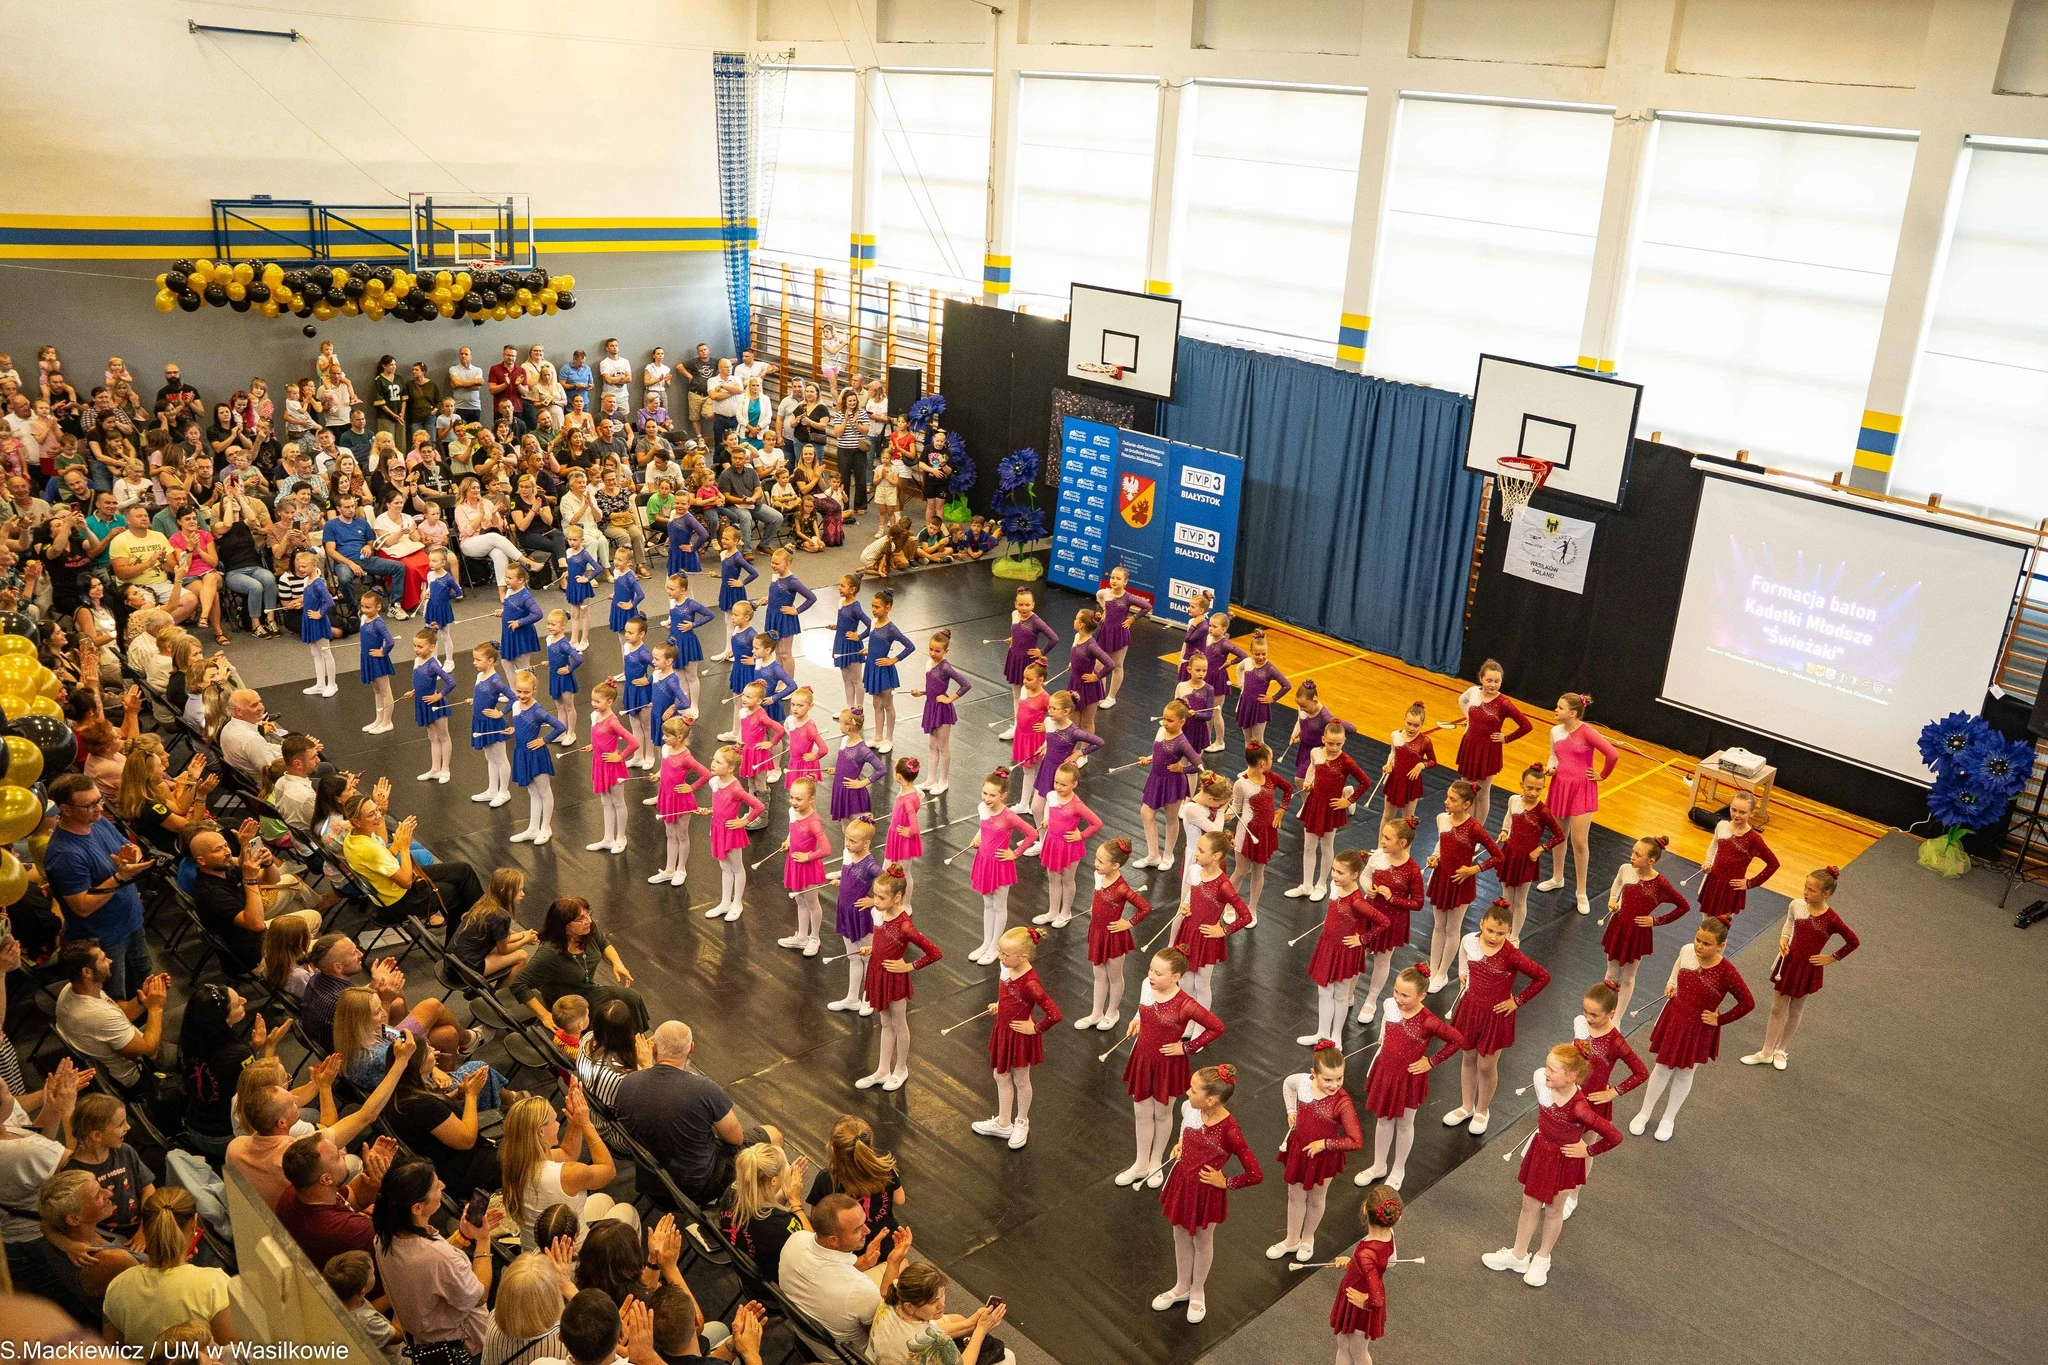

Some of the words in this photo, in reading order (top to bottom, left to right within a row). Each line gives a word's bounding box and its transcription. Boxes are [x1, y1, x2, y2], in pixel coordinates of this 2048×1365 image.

[388, 384, 400, 401] 12
[1186, 471, 1210, 486] TVP
[1212, 476, 1221, 490] 3
[1181, 490, 1220, 506] BIAŁYSTOK
[1180, 528, 1204, 543] TVP
[1207, 534, 1216, 548] 3
[1175, 547, 1215, 563] BIAŁYSTOK
[1530, 560, 1559, 573] WASILKÓW
[1532, 568, 1555, 579] POLAND
[1752, 574, 1825, 610] Formacja
[1830, 595, 1877, 622] baton
[1745, 598, 1803, 627] Kadetki
[1806, 615, 1873, 646] Młodsze
[1762, 625, 1844, 661] "Świeżaki"
[875, 1192, 888, 1222] SILKÓW
